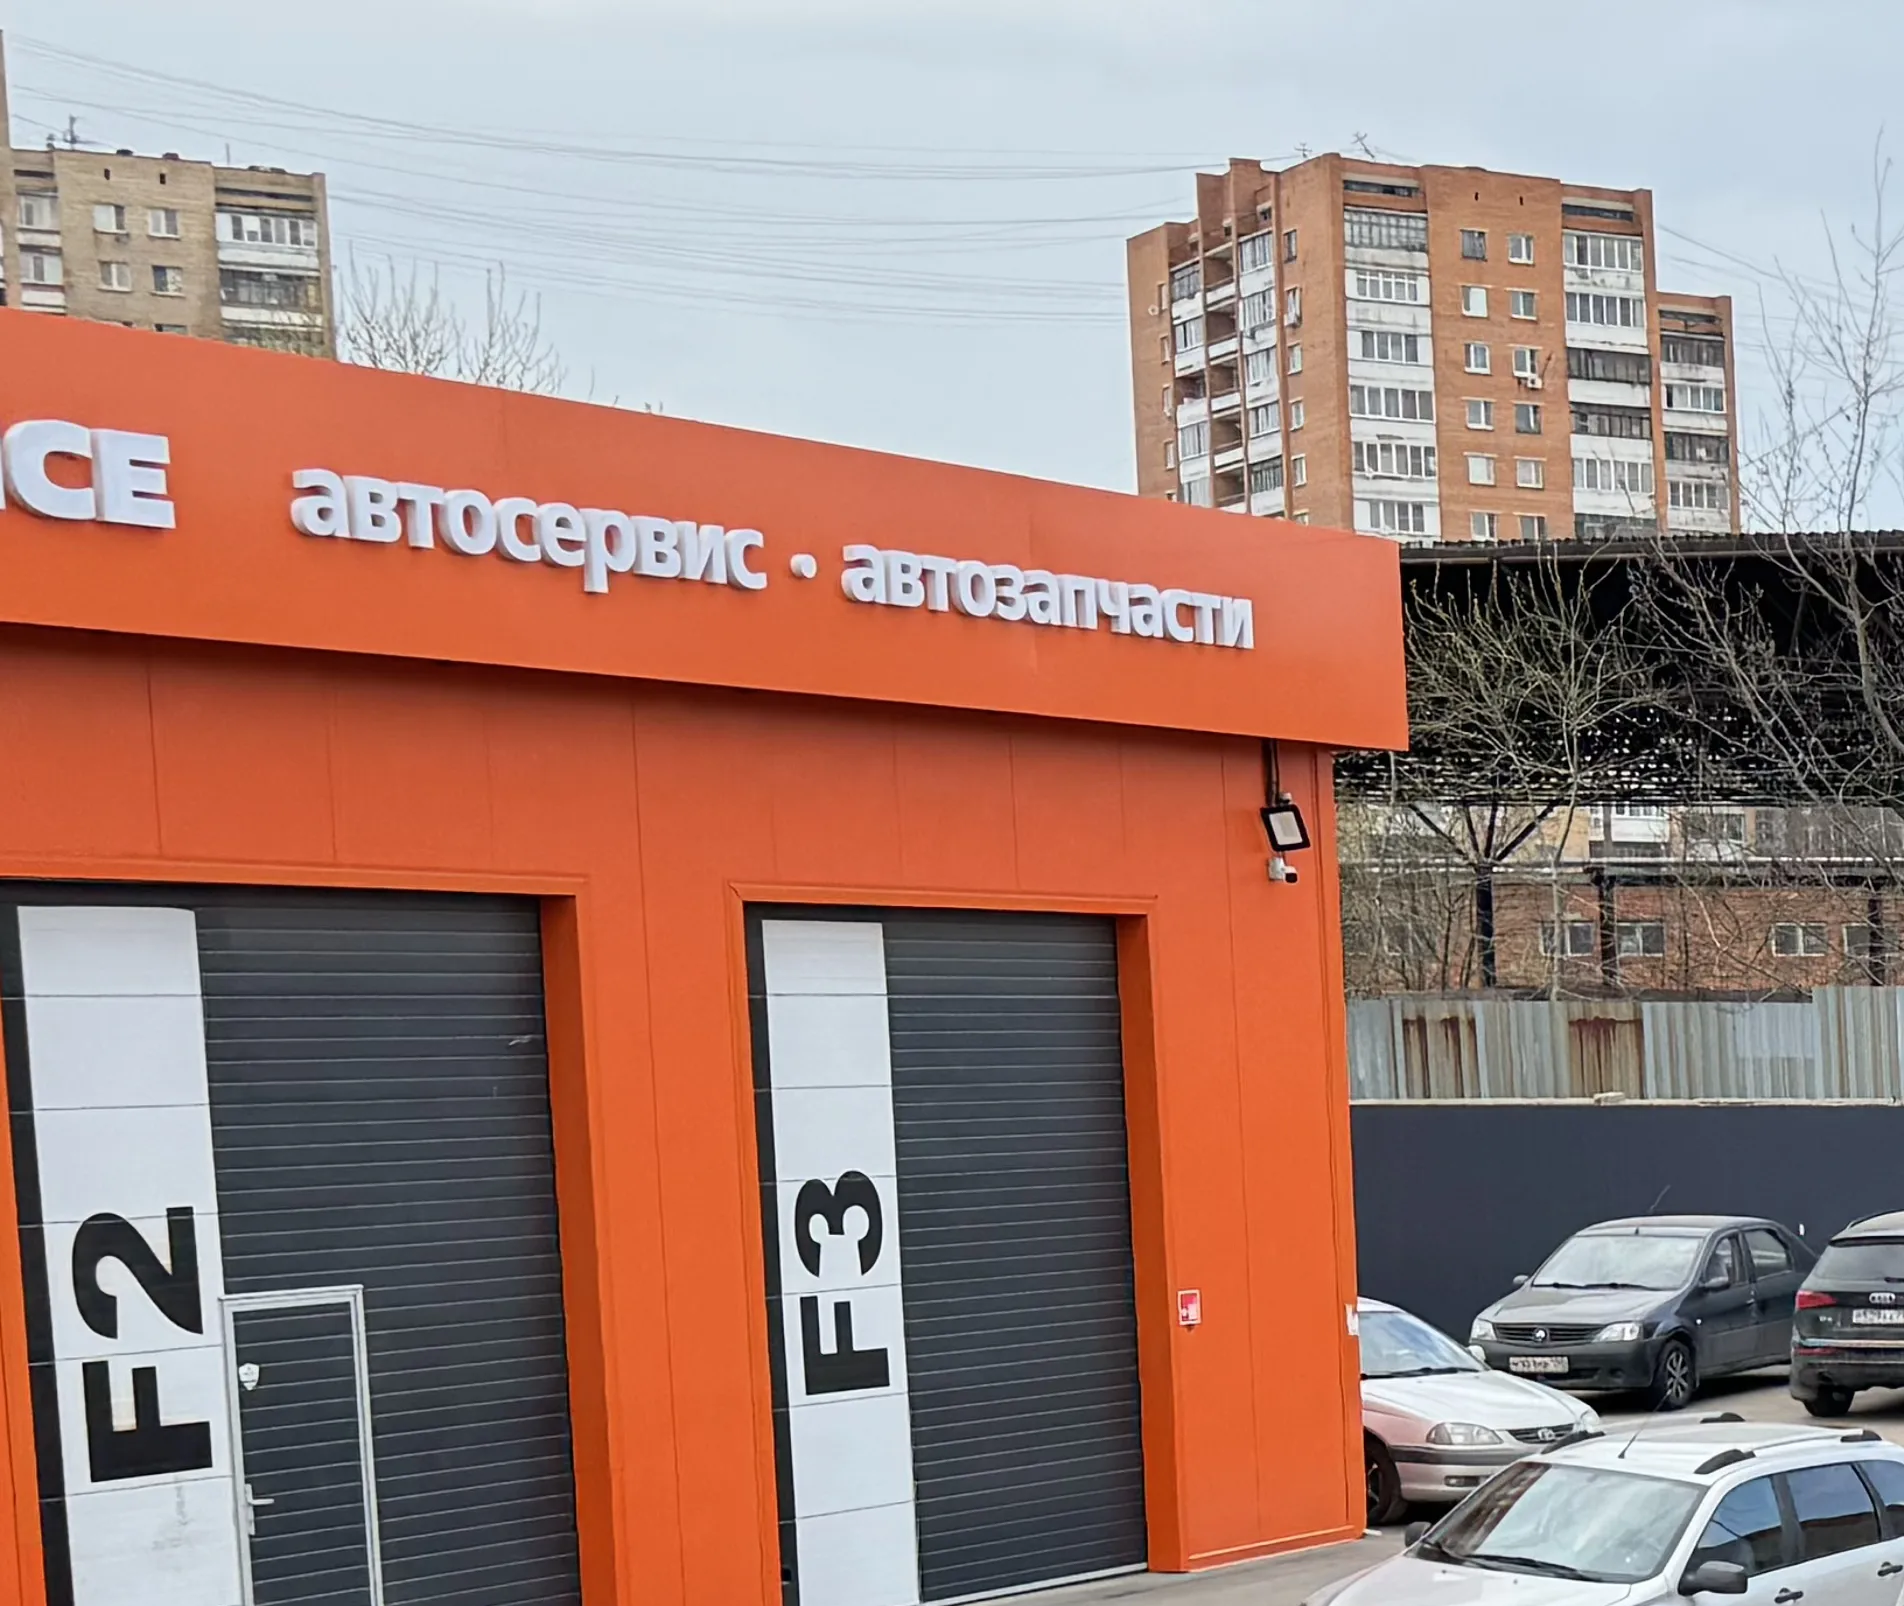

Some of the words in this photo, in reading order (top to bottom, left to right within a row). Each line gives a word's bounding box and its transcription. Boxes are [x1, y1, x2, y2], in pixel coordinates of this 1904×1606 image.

[0, 418, 176, 529] CE
[290, 467, 767, 594] автосервис
[840, 543, 1256, 649] автозапчасти
[72, 1205, 213, 1484] F2
[794, 1169, 891, 1398] F3
